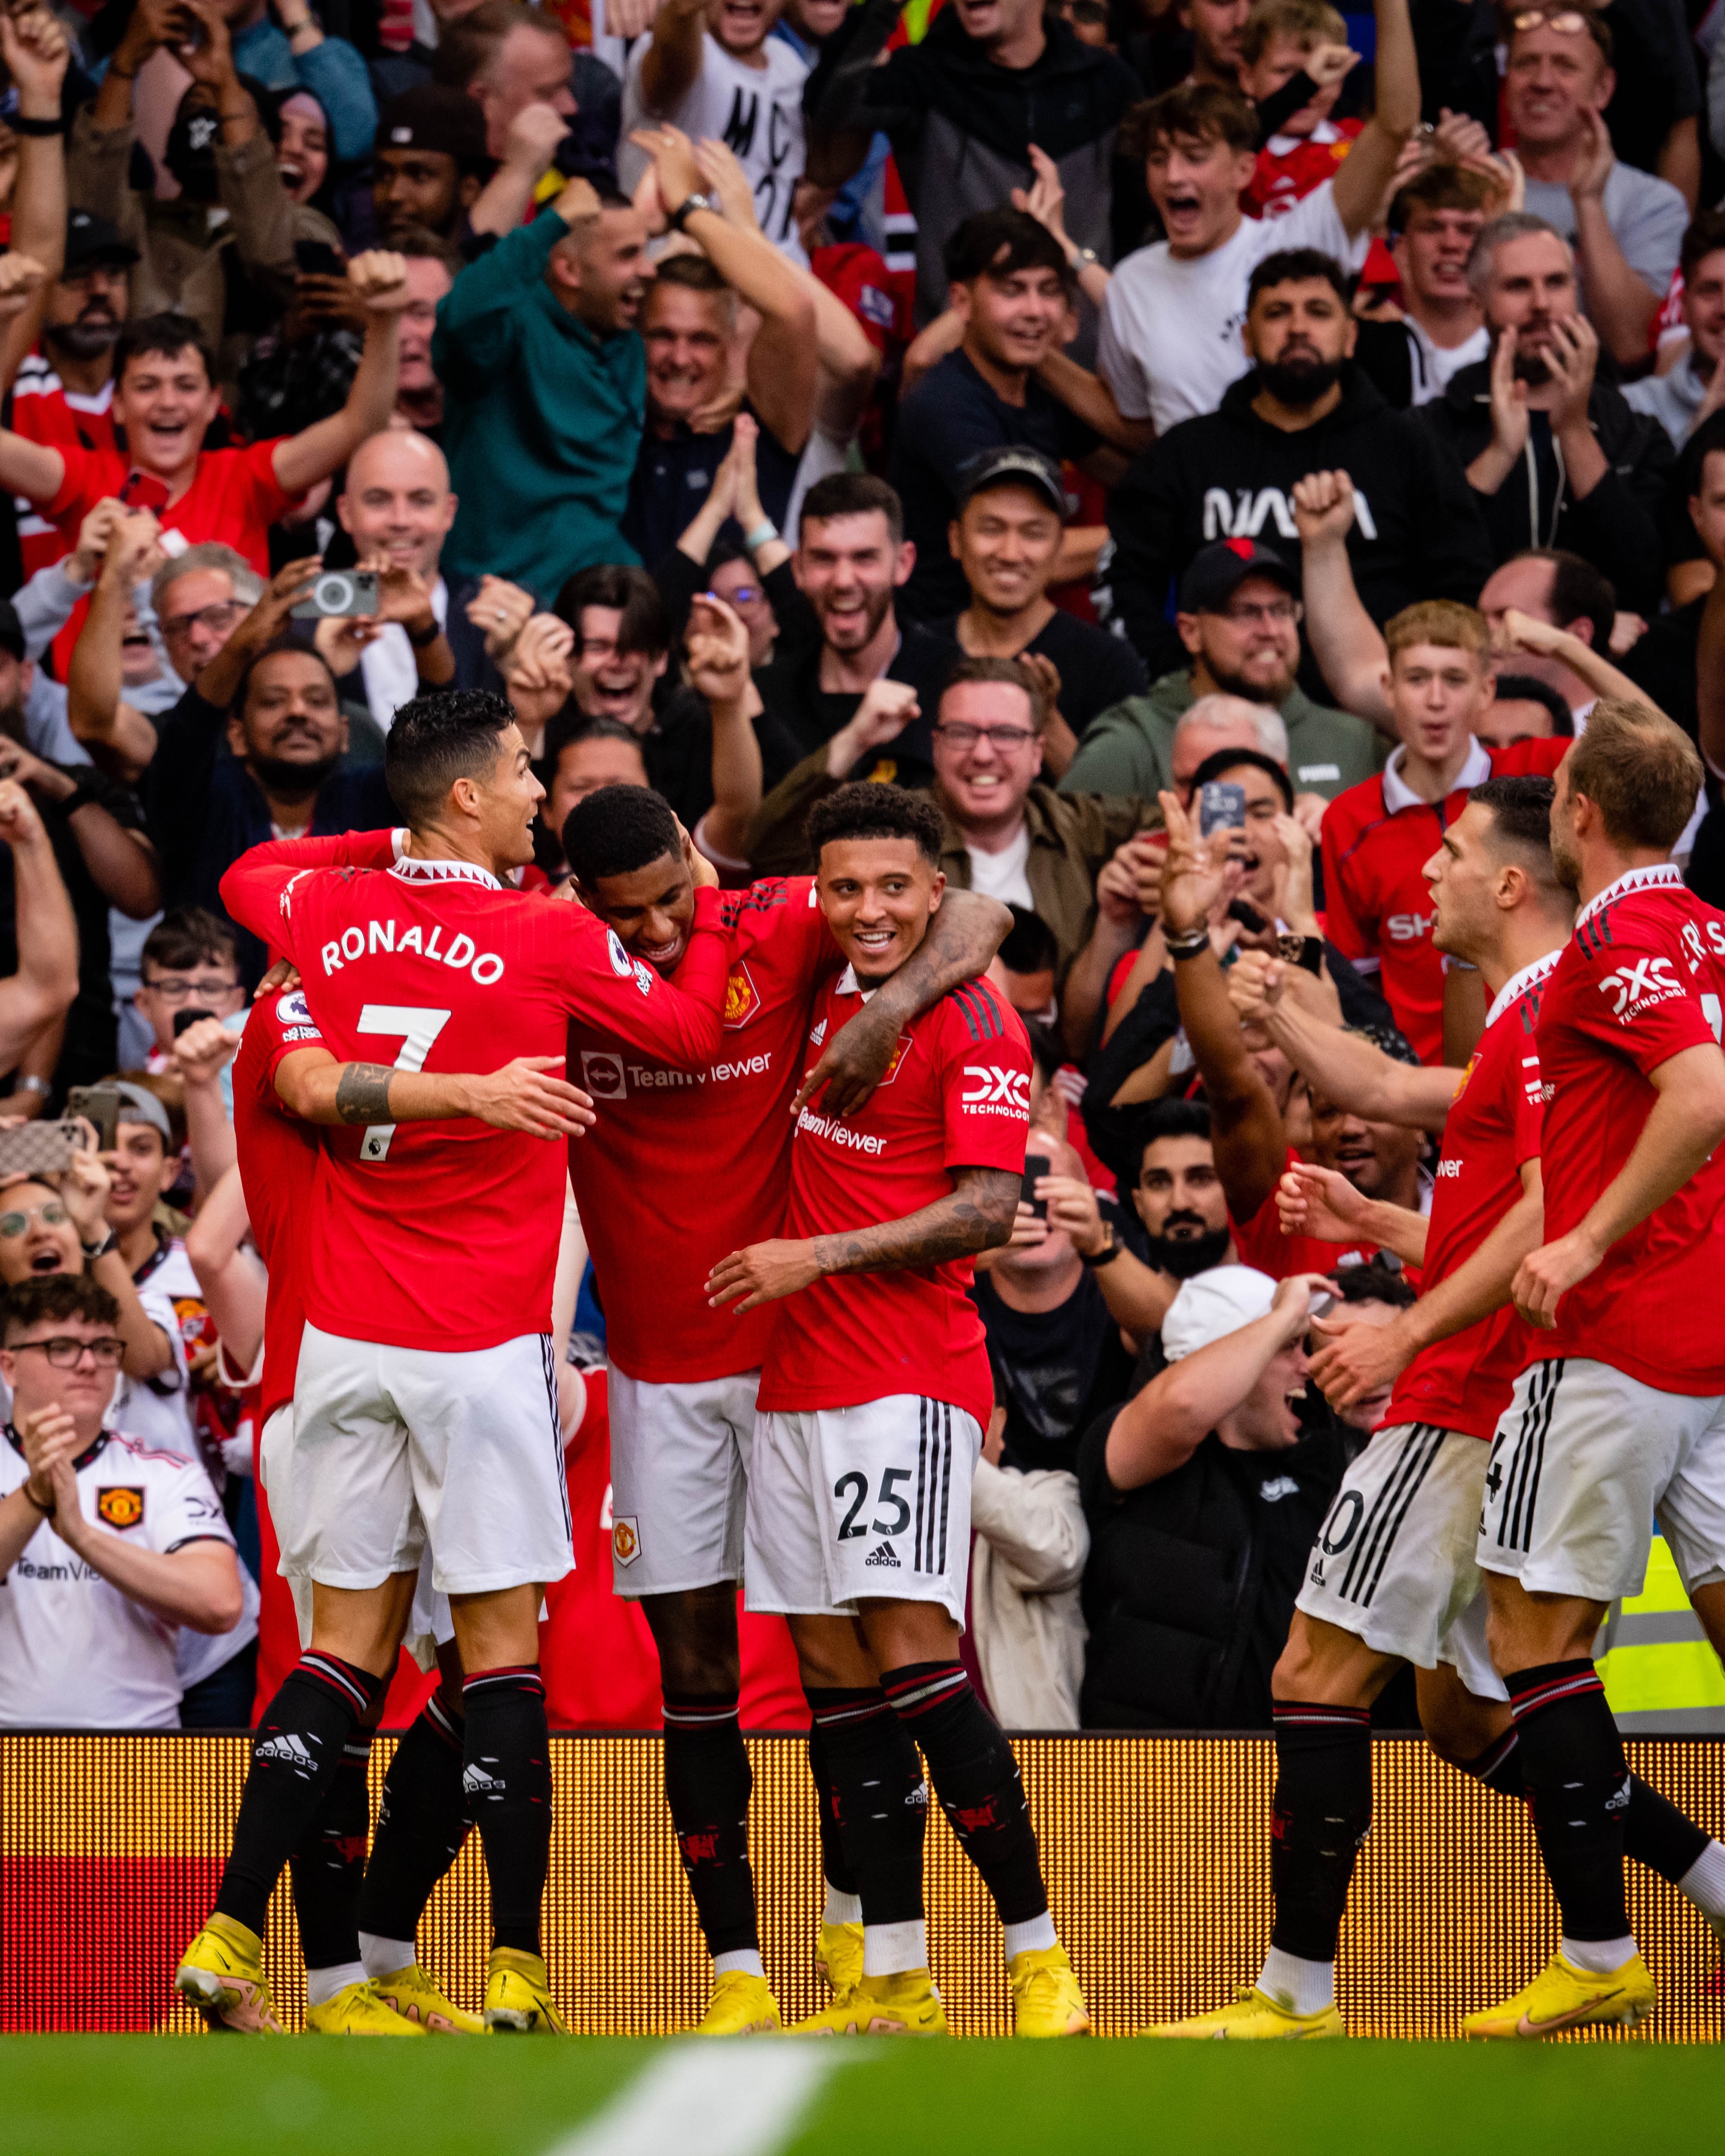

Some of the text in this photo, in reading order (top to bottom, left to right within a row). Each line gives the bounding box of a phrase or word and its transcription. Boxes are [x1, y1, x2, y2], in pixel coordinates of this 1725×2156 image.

[1203, 485, 1378, 540] NA
[321, 920, 504, 985] RONALDO
[1598, 957, 1681, 1015] DXC
[1618, 987, 1687, 1026] TECHNOLOGY
[356, 1004, 452, 1162] 7
[962, 1065, 1030, 1110] DXC
[797, 1105, 887, 1155] TeamViewer
[834, 1467, 913, 1542] 25
[1313, 1490, 1364, 1556] 0
[865, 1556, 902, 1568] adidas
[255, 1747, 318, 1771] adidas
